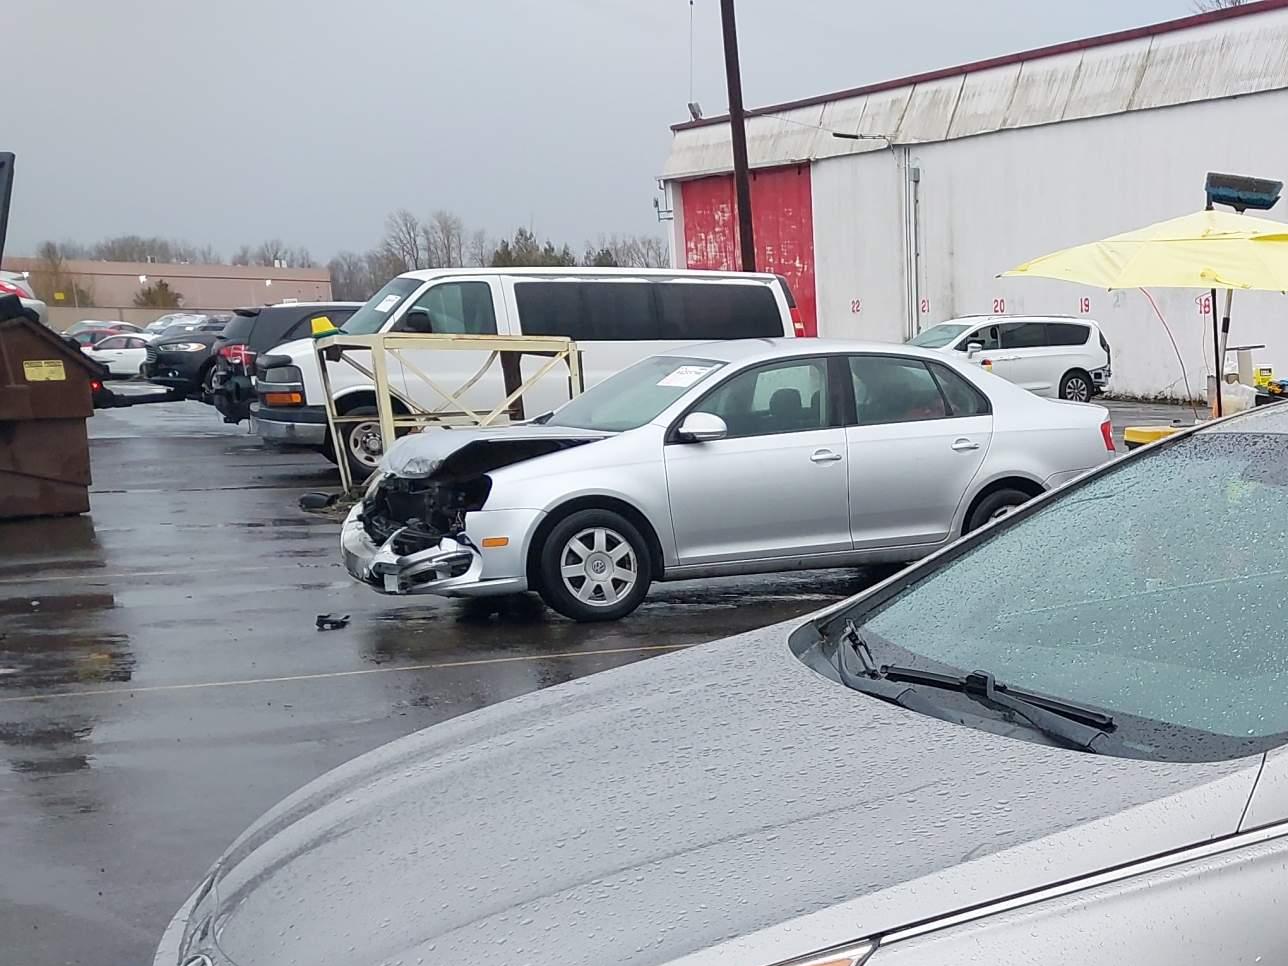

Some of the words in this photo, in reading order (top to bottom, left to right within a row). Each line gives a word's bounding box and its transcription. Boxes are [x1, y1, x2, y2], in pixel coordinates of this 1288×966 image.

[851, 299, 861, 313] 22
[921, 299, 930, 313] 21
[993, 299, 1005, 313] 20
[1079, 297, 1090, 313] 19
[1199, 297, 1211, 315] 18
